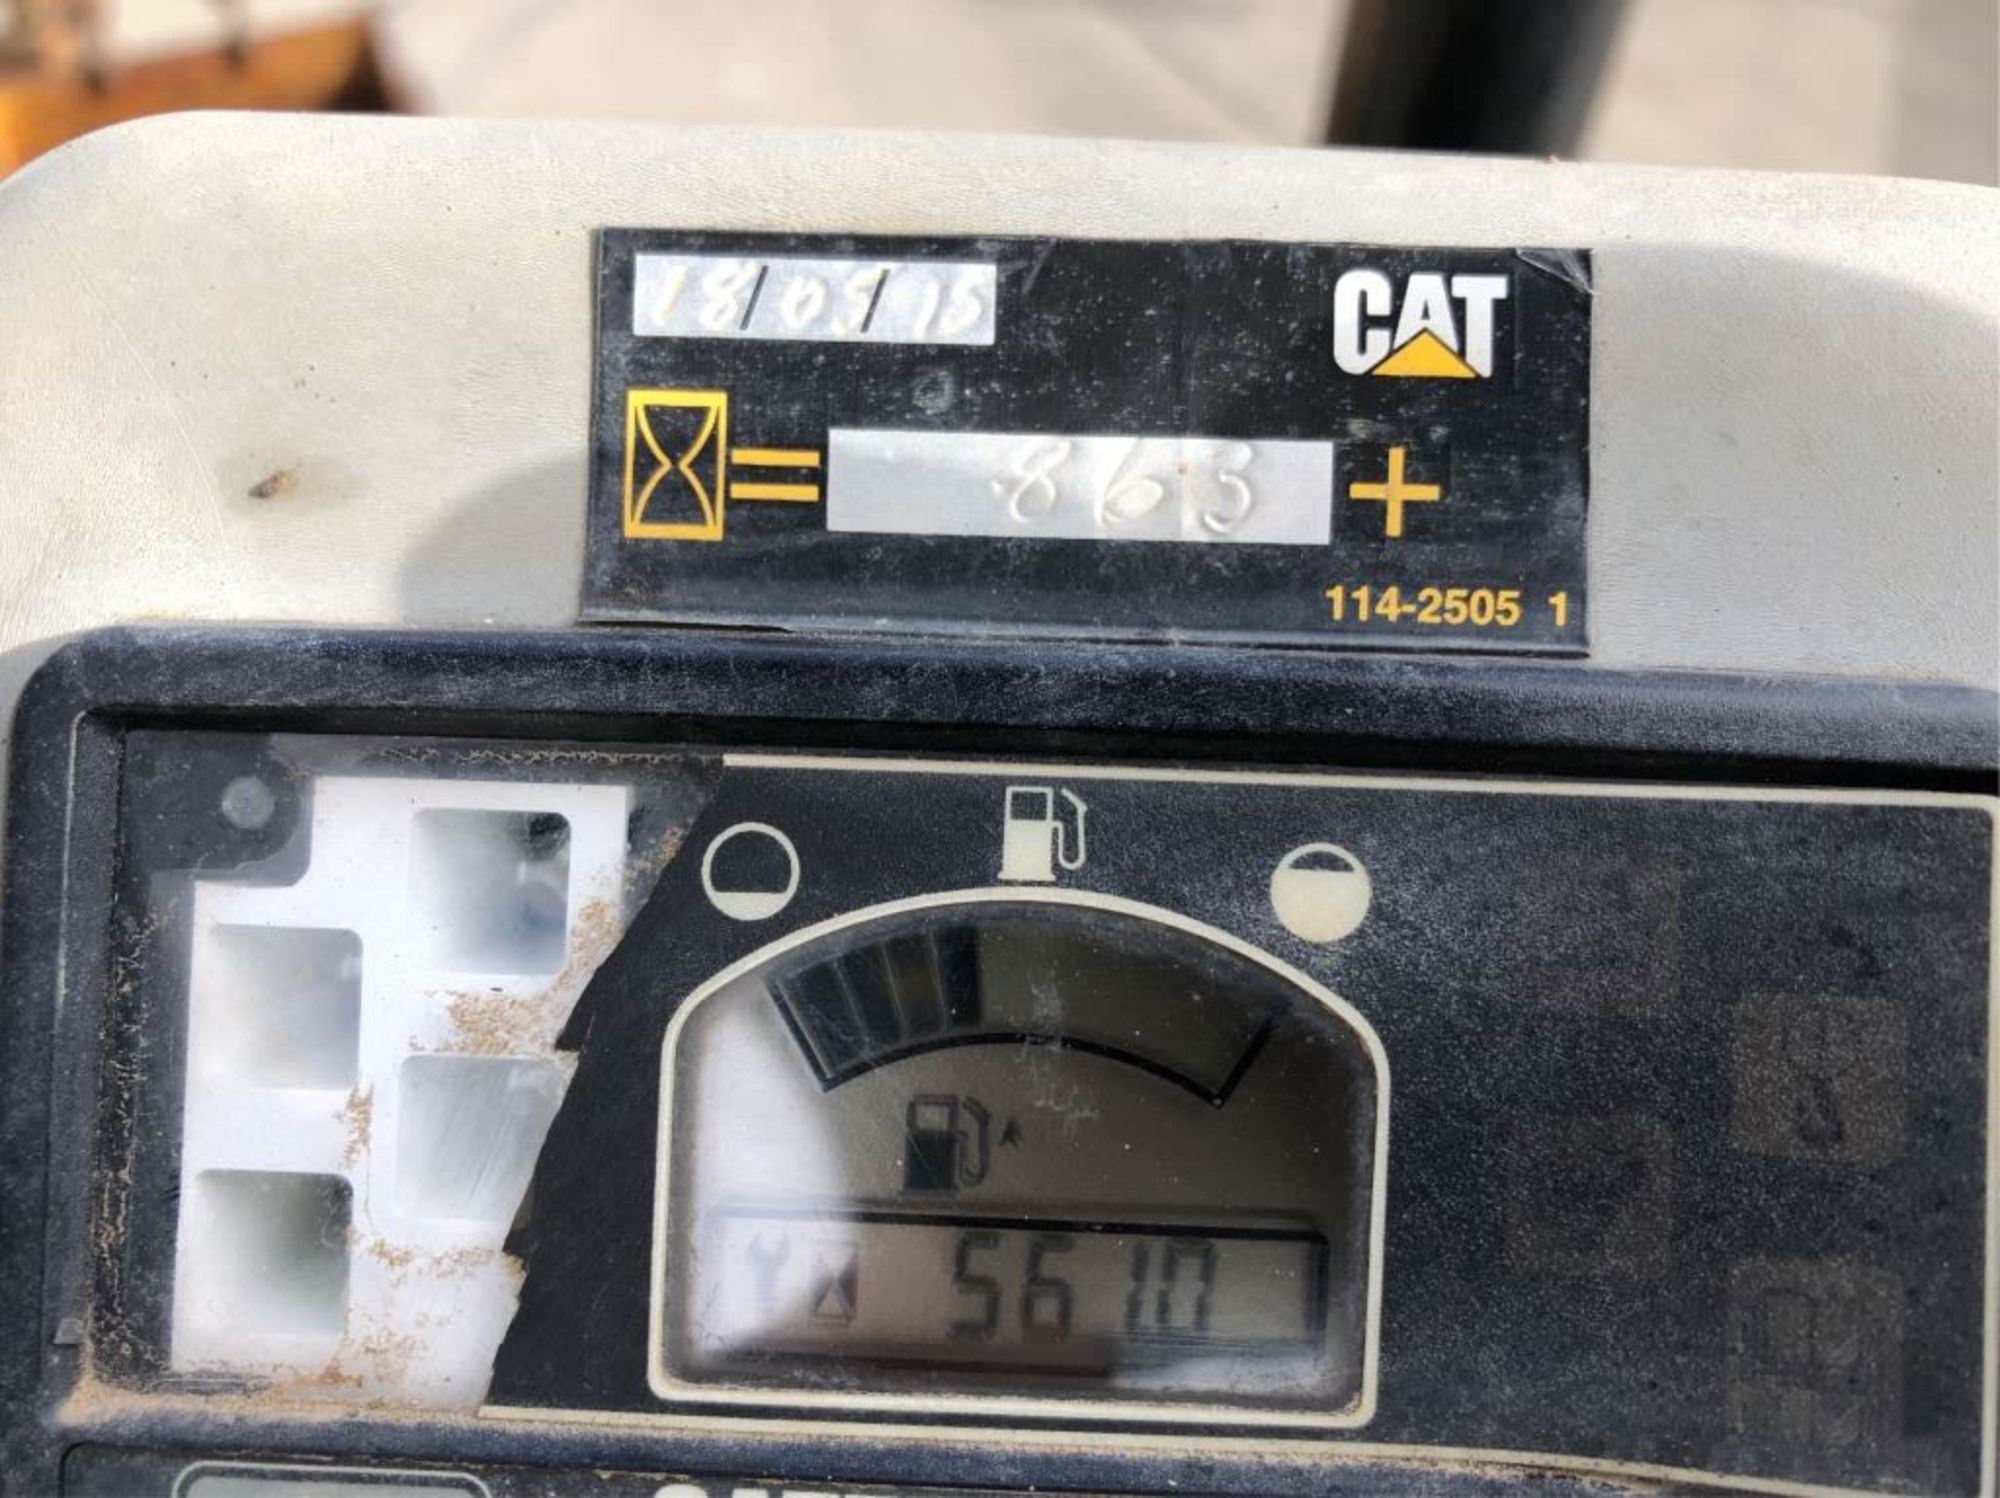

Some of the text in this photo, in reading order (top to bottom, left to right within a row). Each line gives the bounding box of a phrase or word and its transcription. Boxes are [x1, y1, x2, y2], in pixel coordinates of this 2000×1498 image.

[1332, 269, 1509, 379] CAT
[1325, 584, 1568, 628] 114-2505 1
